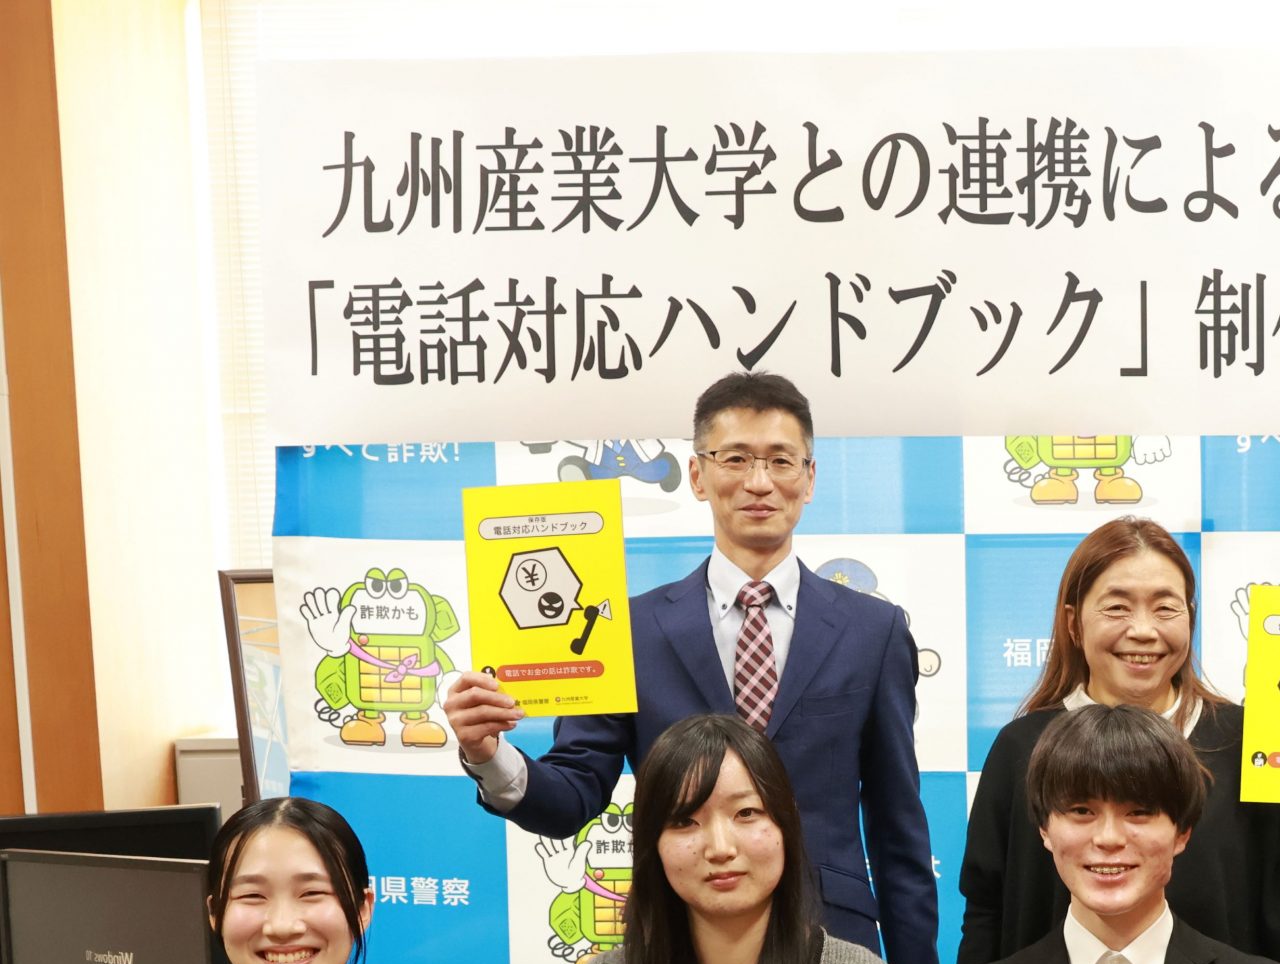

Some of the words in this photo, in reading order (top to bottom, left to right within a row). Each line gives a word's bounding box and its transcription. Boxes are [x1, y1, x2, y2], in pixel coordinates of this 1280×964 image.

[493, 522, 587, 535] 電話対応ハンドブック
[360, 605, 418, 620] 詐欺かも
[505, 666, 596, 677] 電話でお金の話は詐欺です。
